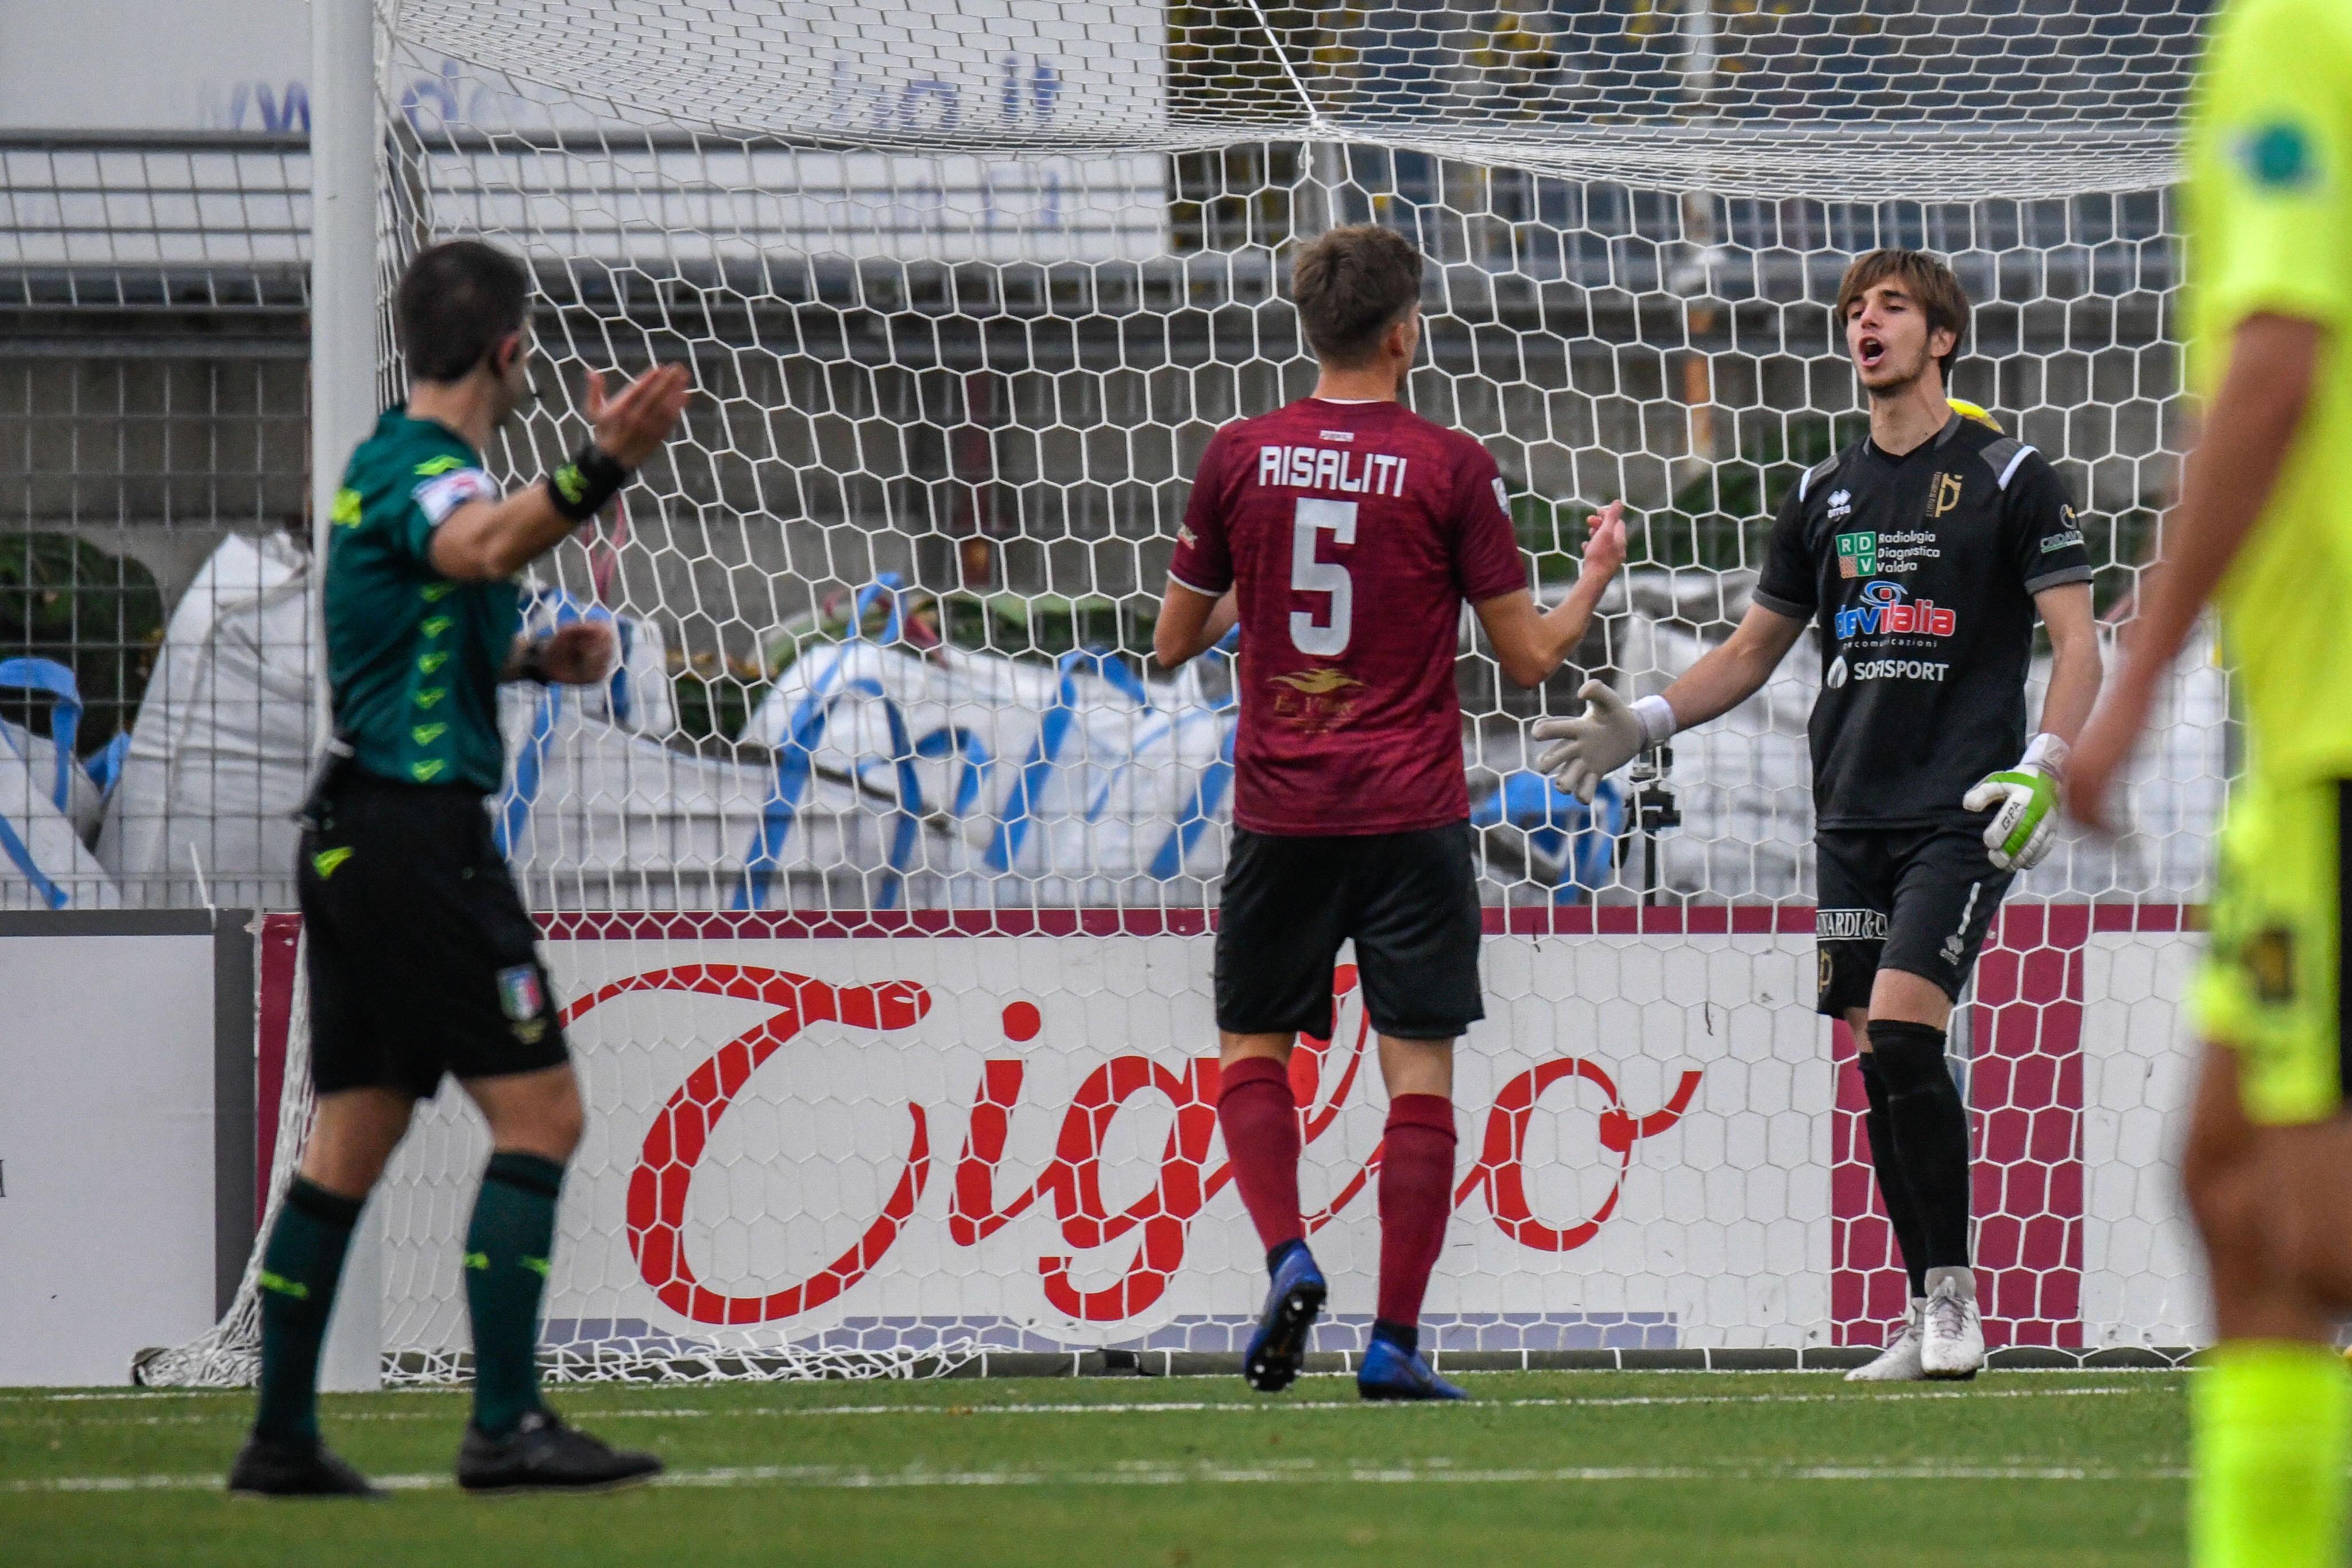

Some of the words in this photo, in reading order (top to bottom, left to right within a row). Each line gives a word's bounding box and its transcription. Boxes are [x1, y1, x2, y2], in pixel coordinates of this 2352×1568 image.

[1258, 446, 1407, 497] RISALITI
[1289, 497, 1359, 656] 5
[558, 964, 1702, 1325] Tiglo
